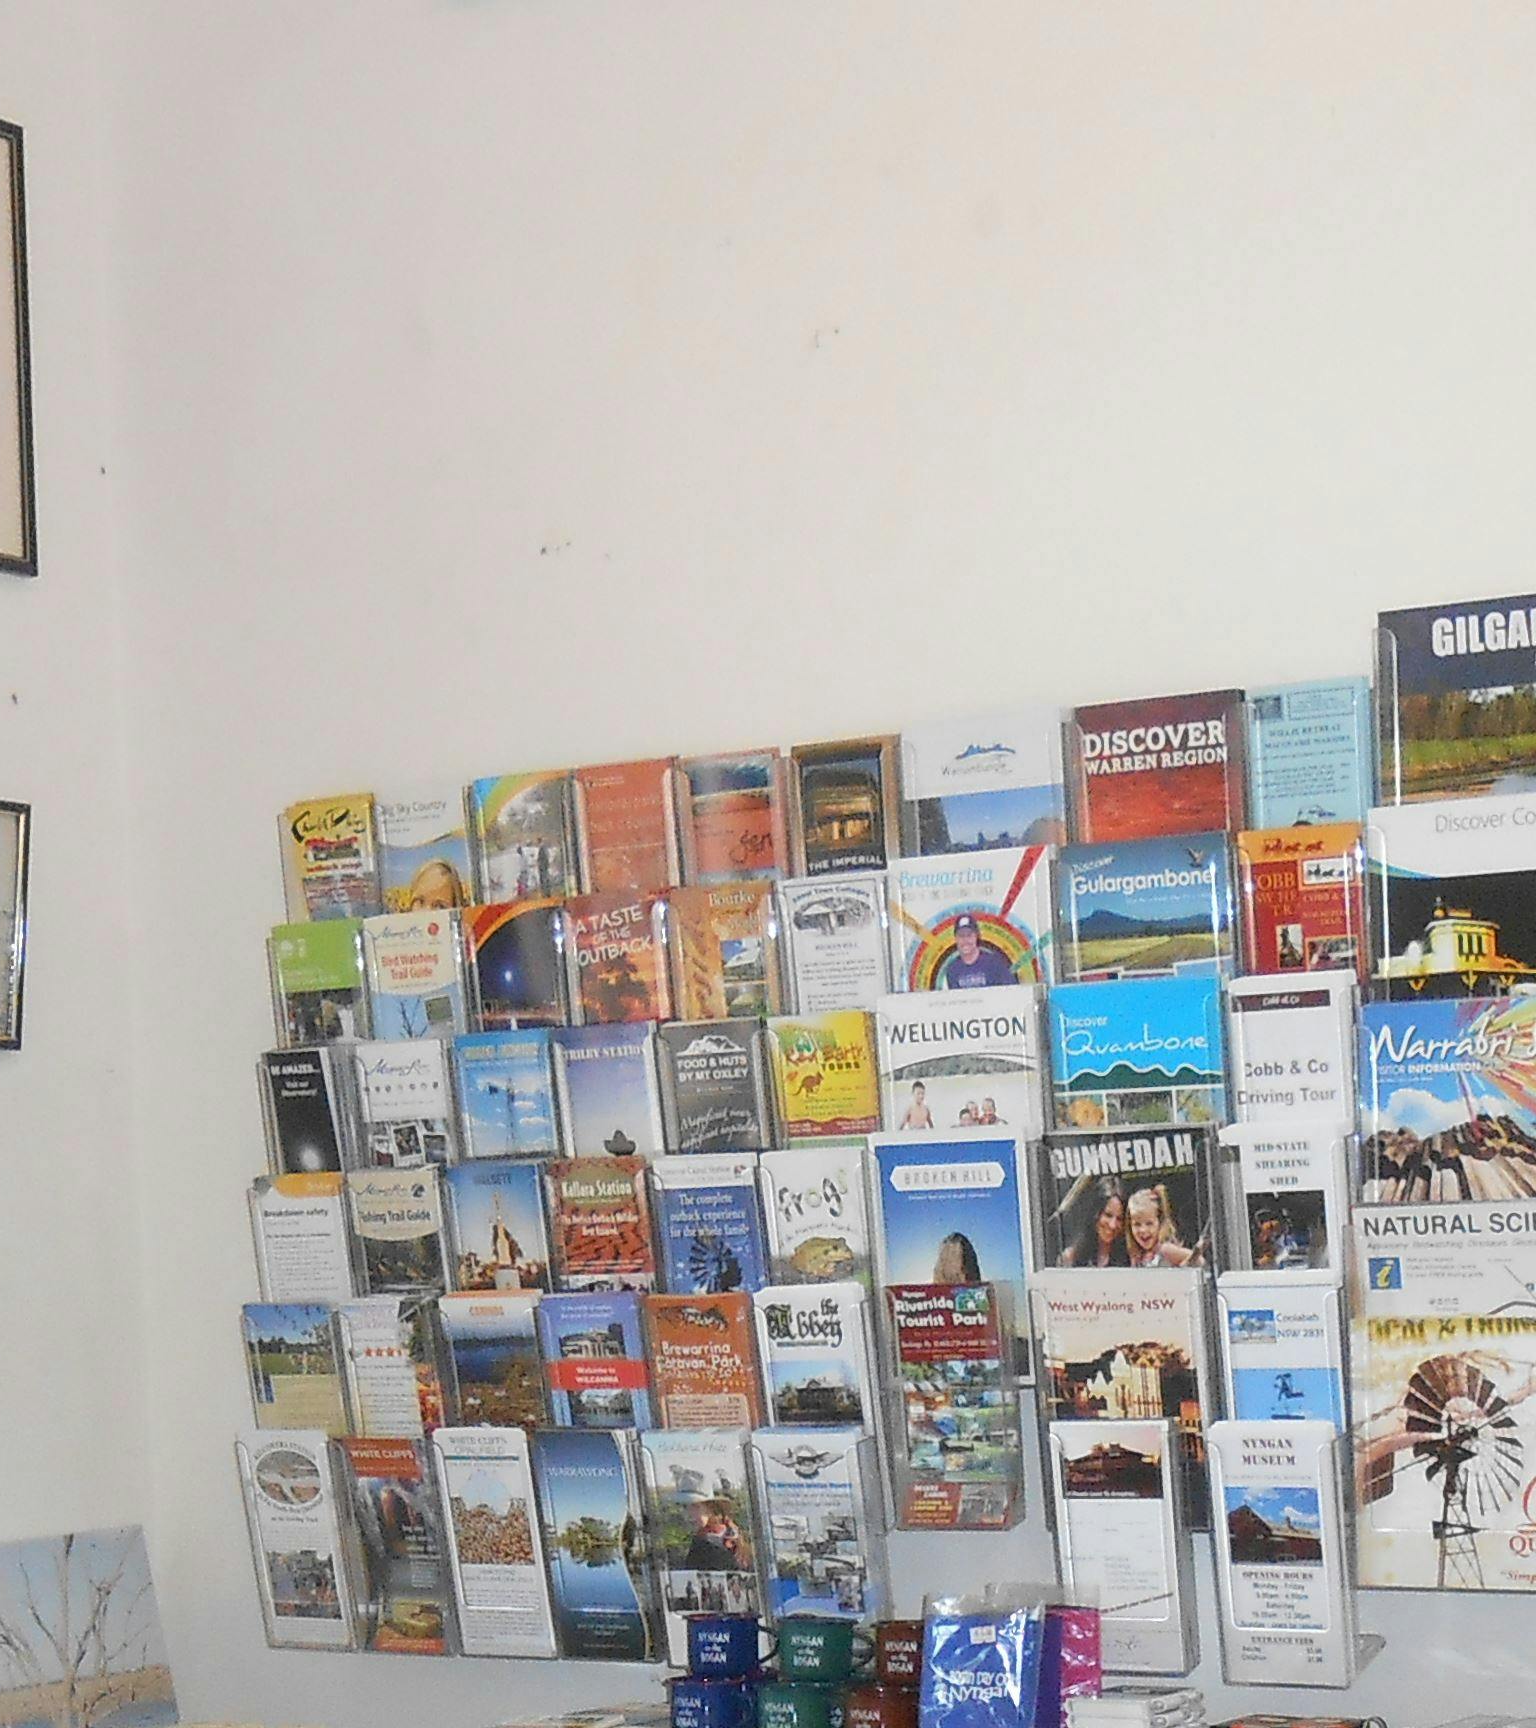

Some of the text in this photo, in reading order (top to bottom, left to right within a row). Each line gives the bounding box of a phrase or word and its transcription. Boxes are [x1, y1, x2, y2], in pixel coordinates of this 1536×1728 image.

[1083, 720, 1224, 758] DISCOVER
[1084, 747, 1227, 776] WARREN REGION
[1435, 814, 1504, 833] Discover
[808, 854, 884, 872] THE IMPERIAL
[1073, 867, 1214, 895] Gulargambone
[576, 904, 644, 934] A TASTE
[579, 935, 653, 966] OUTBACK
[889, 1016, 1026, 1044] WELLINGTON
[1062, 1022, 1208, 1056] Quambone
[1371, 1014, 1513, 1062] Narrabri
[677, 1055, 747, 1070] FOOD HUTS
[1244, 1059, 1329, 1077] Cobb & Co
[678, 1067, 749, 1082] BY MT OXLEY
[1238, 1087, 1337, 1106] Driving Tour
[1048, 1133, 1194, 1179] GUNNEDAH
[904, 1170, 992, 1185] BROKEN HILL
[596, 1180, 632, 1196] Station
[1364, 1214, 1482, 1237] NATURAL
[895, 1297, 954, 1313] Riverside
[1048, 1299, 1176, 1314] West Wyalong NSW
[898, 1314, 945, 1328] Tourist
[661, 1341, 731, 1354] Brewarrina
[711, 1353, 742, 1369] Park
